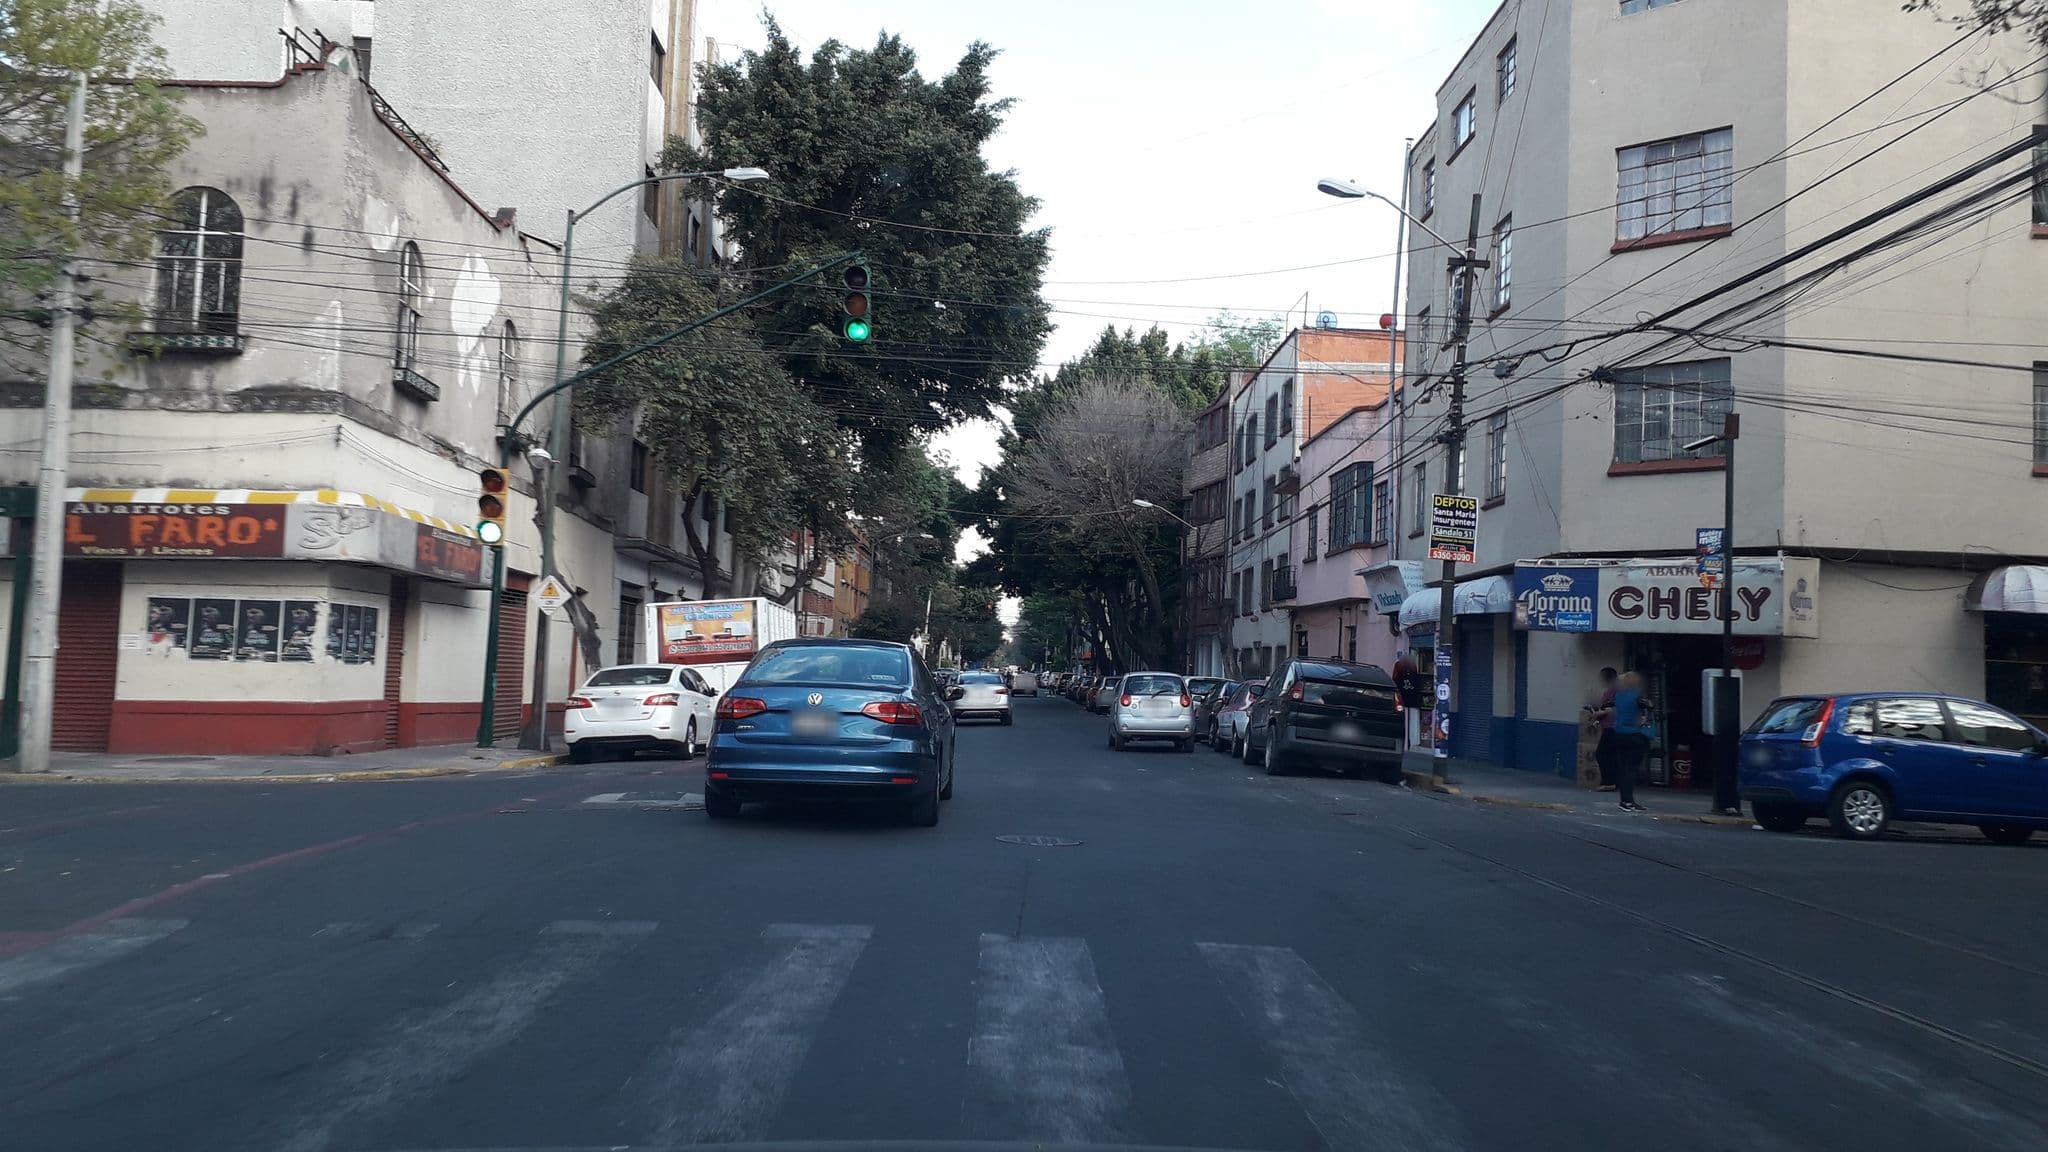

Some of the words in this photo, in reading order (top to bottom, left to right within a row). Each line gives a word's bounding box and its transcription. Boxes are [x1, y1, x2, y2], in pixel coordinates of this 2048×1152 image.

[70, 502, 232, 515] Abarrotes
[1434, 496, 1475, 510] DEPTOS
[1433, 507, 1454, 517] Santa
[1433, 515, 1476, 527] Insurgentes
[65, 513, 97, 543] L
[129, 513, 263, 547] FARO
[81, 545, 127, 555] Vinos
[134, 547, 144, 557] y
[151, 545, 214, 556] Licores
[1645, 566, 1696, 577] ABARR
[1518, 588, 1593, 617] Corona
[1608, 586, 1771, 621] CHELY
[1538, 612, 1556, 626] Ex
